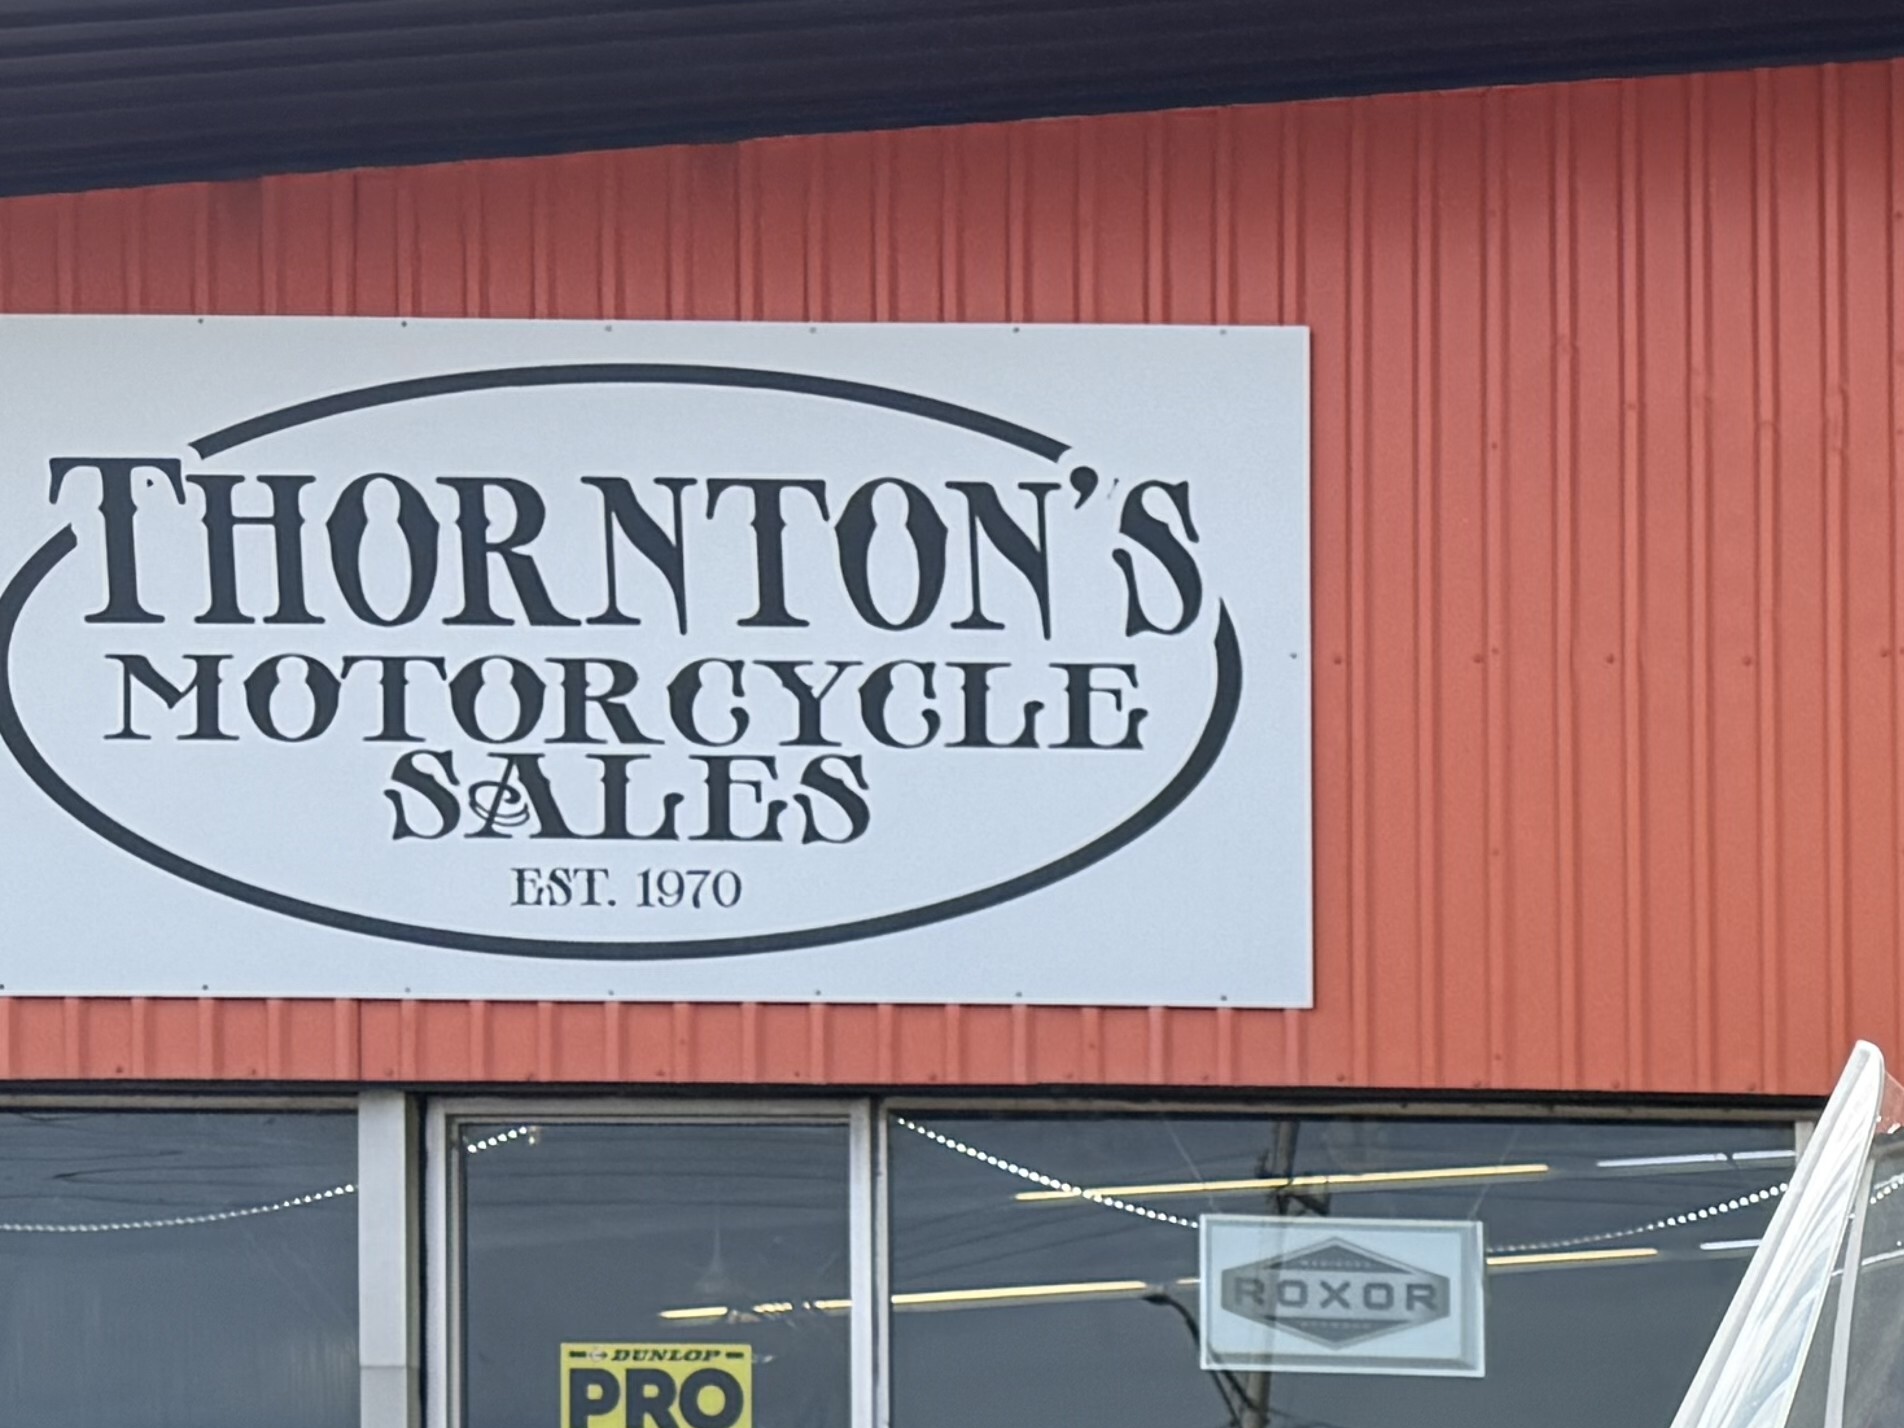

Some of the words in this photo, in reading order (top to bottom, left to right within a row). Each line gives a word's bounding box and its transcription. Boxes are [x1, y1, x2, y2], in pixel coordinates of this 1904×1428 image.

[49, 457, 1203, 638] THORNTON'S
[103, 653, 1149, 750] MOTORCYCLE
[384, 748, 872, 845] SALES
[510, 867, 616, 908] EST.
[636, 867, 743, 909] 1970
[1234, 1276, 1437, 1311] ROXOR
[611, 1349, 721, 1362] DUNLOP
